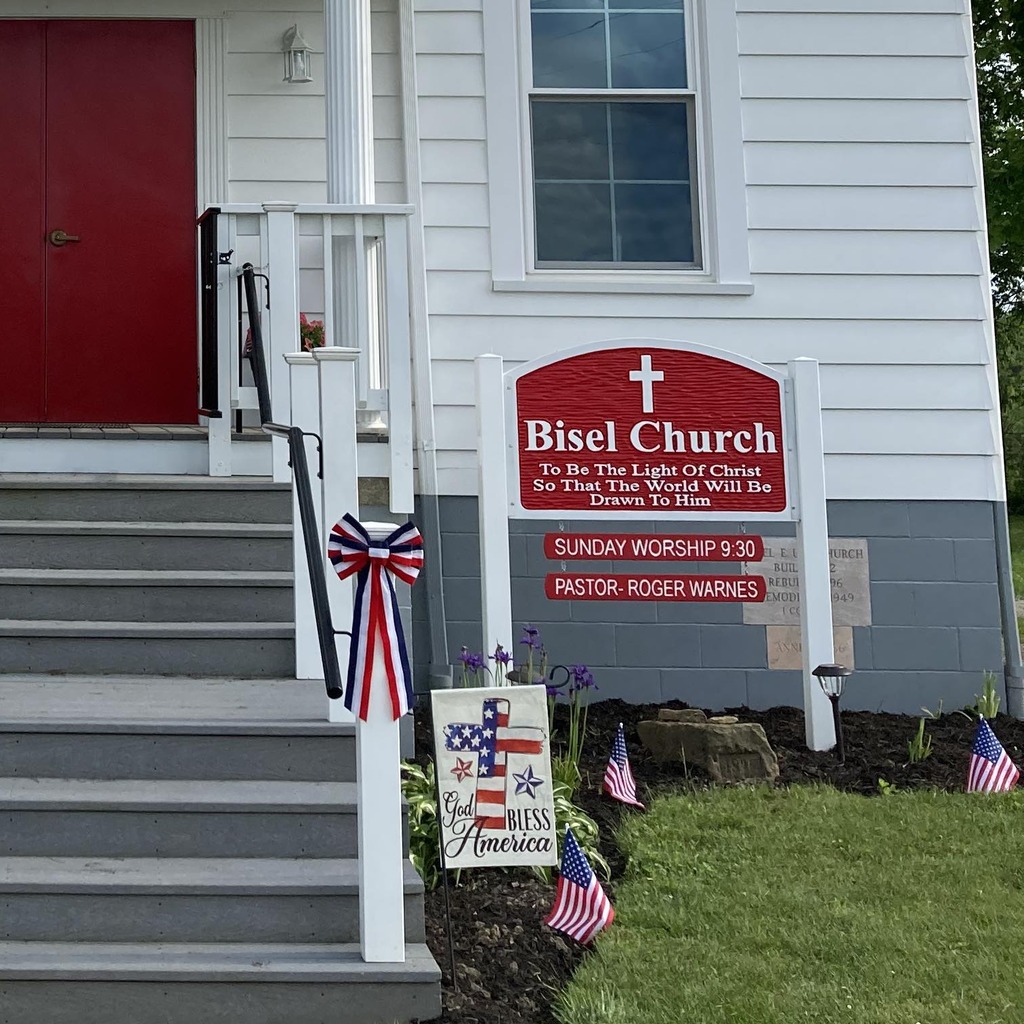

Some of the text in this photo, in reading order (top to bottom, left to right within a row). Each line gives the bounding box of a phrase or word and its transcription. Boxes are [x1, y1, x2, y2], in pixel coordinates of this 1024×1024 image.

[524, 420, 778, 454] Bisel Church
[539, 463, 761, 478] To Be The Light Of Christ
[533, 479, 772, 493] So That The World Will Be
[589, 494, 711, 507] Drawn To Him
[554, 538, 626, 556] SUNDAY
[631, 539, 716, 557] WORSHIP
[720, 540, 755, 557] 9:30
[828, 548, 864, 559] HURCH
[555, 578, 624, 596] PASTOR-
[628, 579, 686, 597] ROGER
[689, 580, 758, 598] WARNES
[443, 791, 551, 831] God BLESS
[445, 816, 553, 858] America
